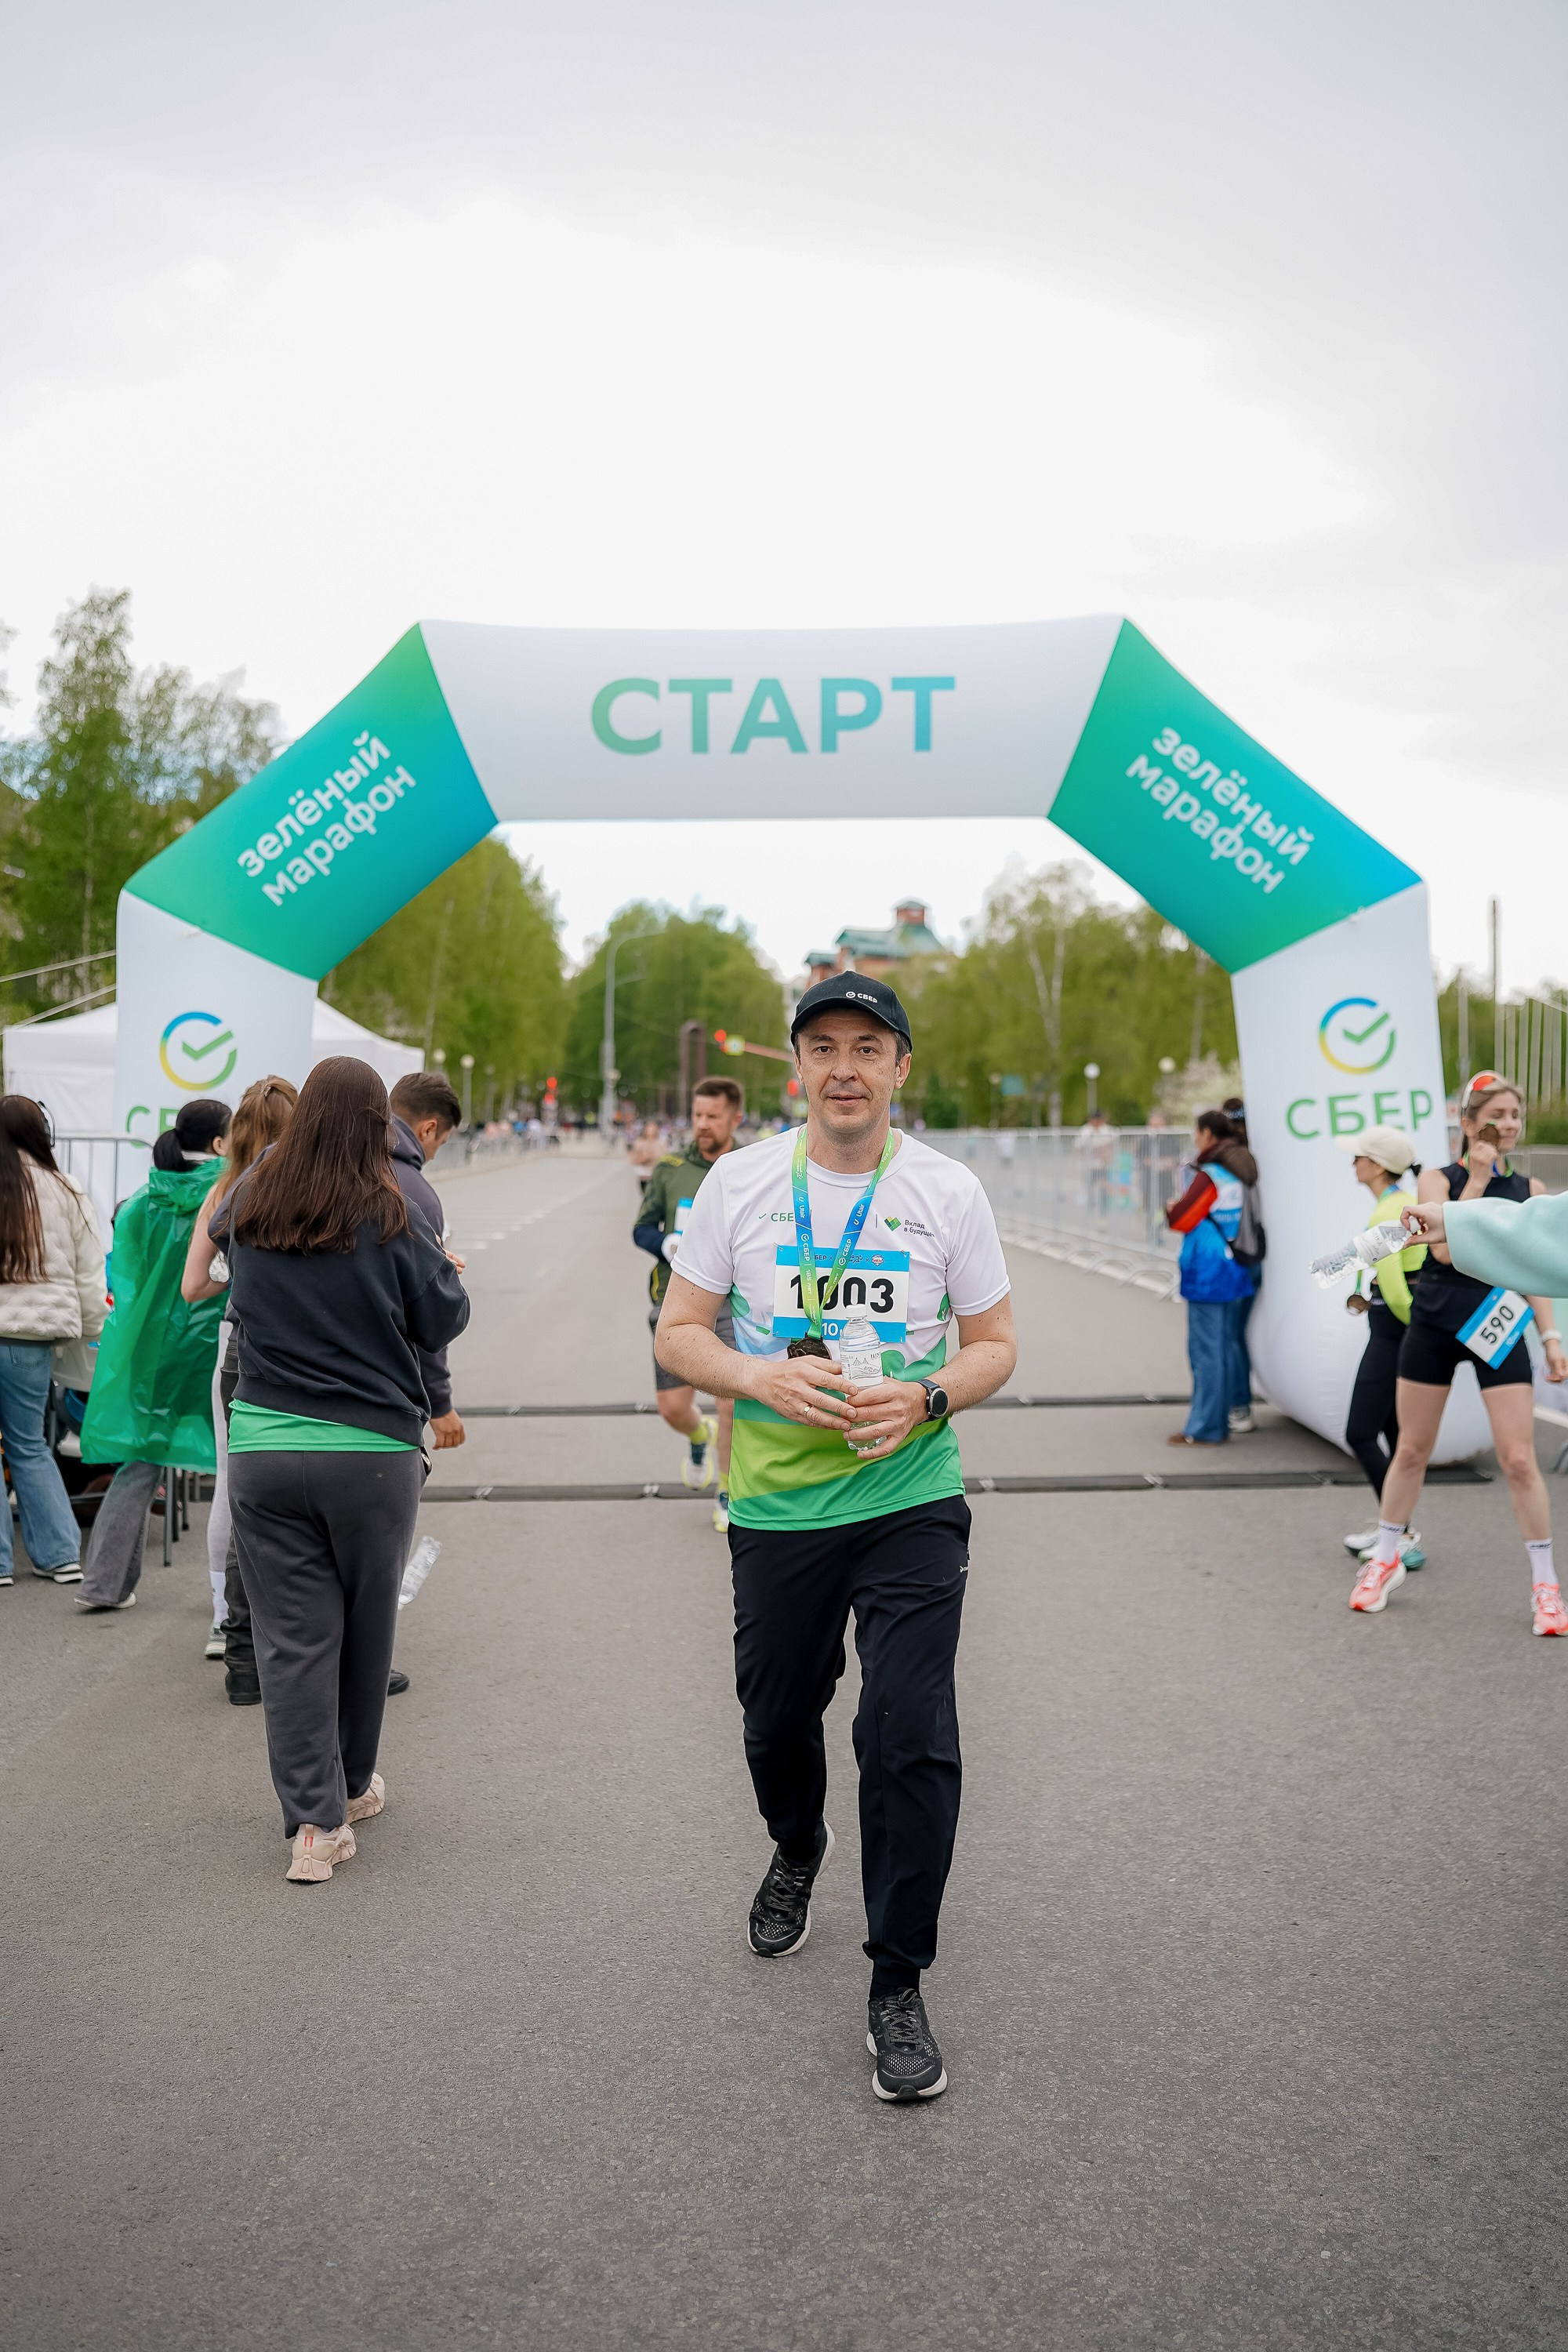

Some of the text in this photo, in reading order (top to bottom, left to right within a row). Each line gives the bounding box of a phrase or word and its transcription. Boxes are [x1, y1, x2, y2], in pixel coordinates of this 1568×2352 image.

[591, 676, 956, 757] СТАРТ
[237, 729, 391, 878] зелёный
[1151, 726, 1316, 866] зелёный
[261, 764, 416, 907] марафон
[1125, 753, 1286, 894] марафон
[857, 993, 878, 1004] СБЕР
[1286, 1090, 1434, 1140] СБЕР
[771, 1212, 795, 1222] СБЕ
[904, 1219, 925, 1229] Вклад
[842, 1239, 852, 1257] СБЕР
[790, 1274, 895, 1314] 1003
[822, 1322, 839, 1337] 10
[1480, 1305, 1514, 1345] 590
